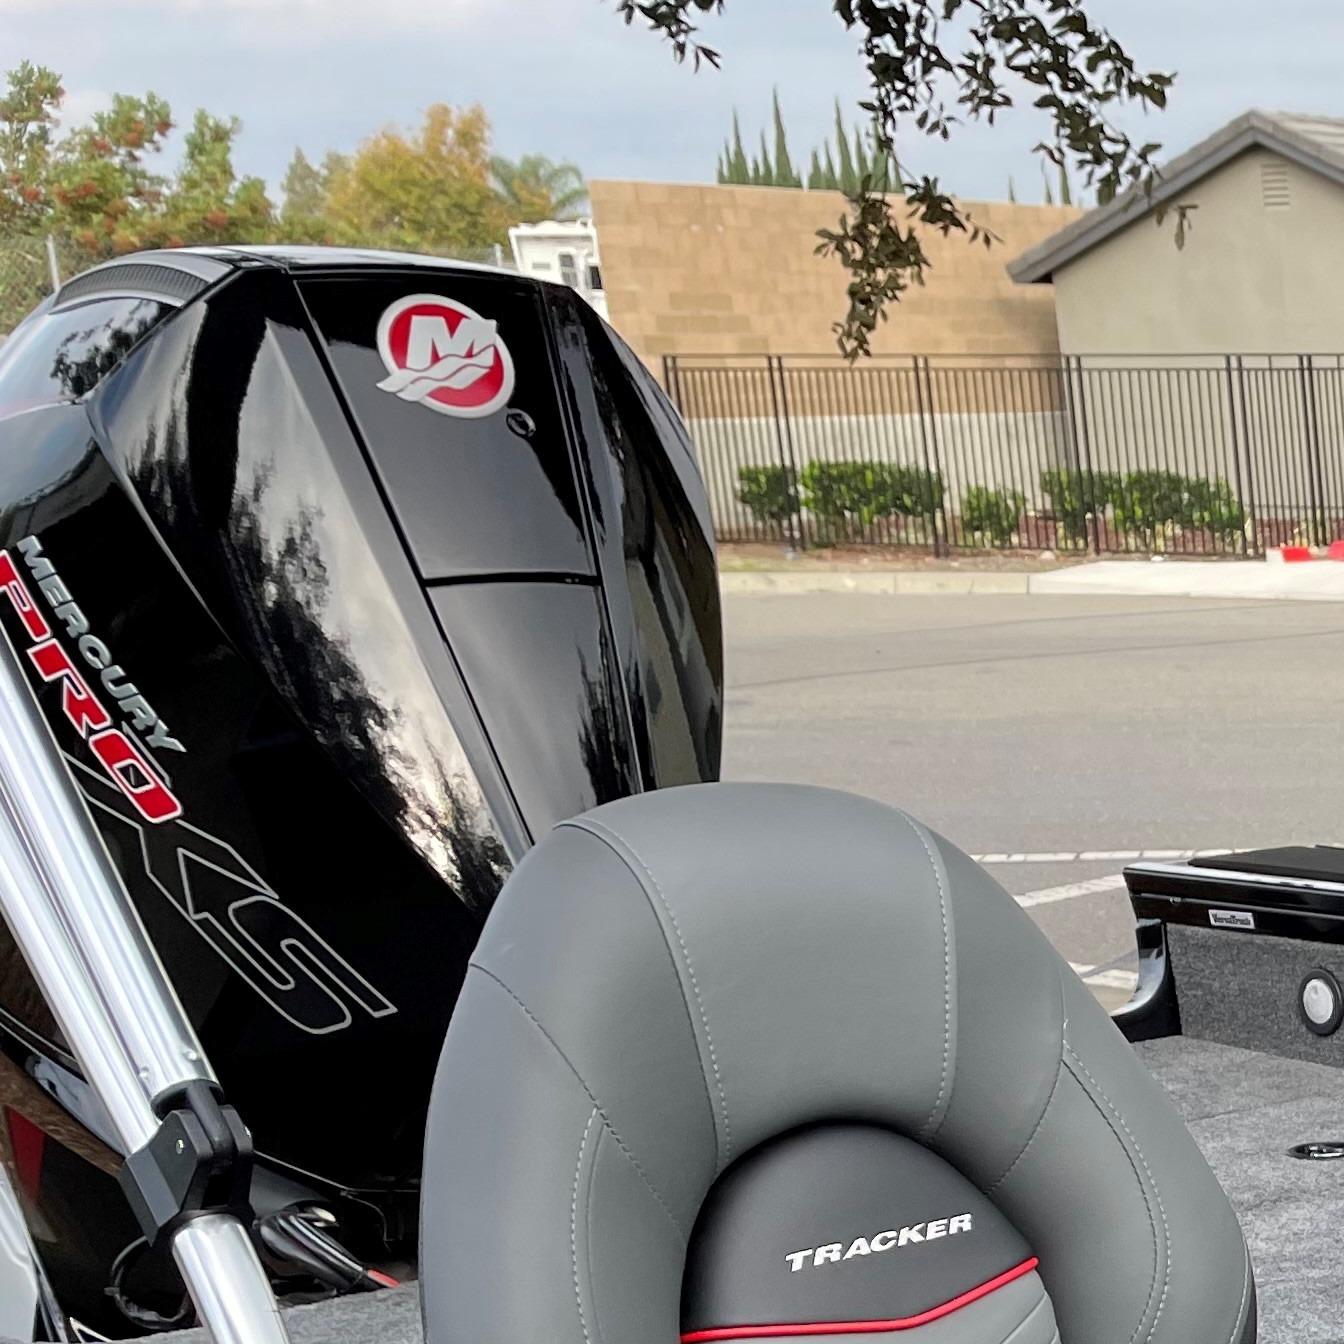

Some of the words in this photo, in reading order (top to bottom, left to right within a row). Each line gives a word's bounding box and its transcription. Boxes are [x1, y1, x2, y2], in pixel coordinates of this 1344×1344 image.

[0, 549, 183, 824] PRO
[16, 535, 187, 753] MERCURY
[785, 1213, 973, 1272] TRACKER
